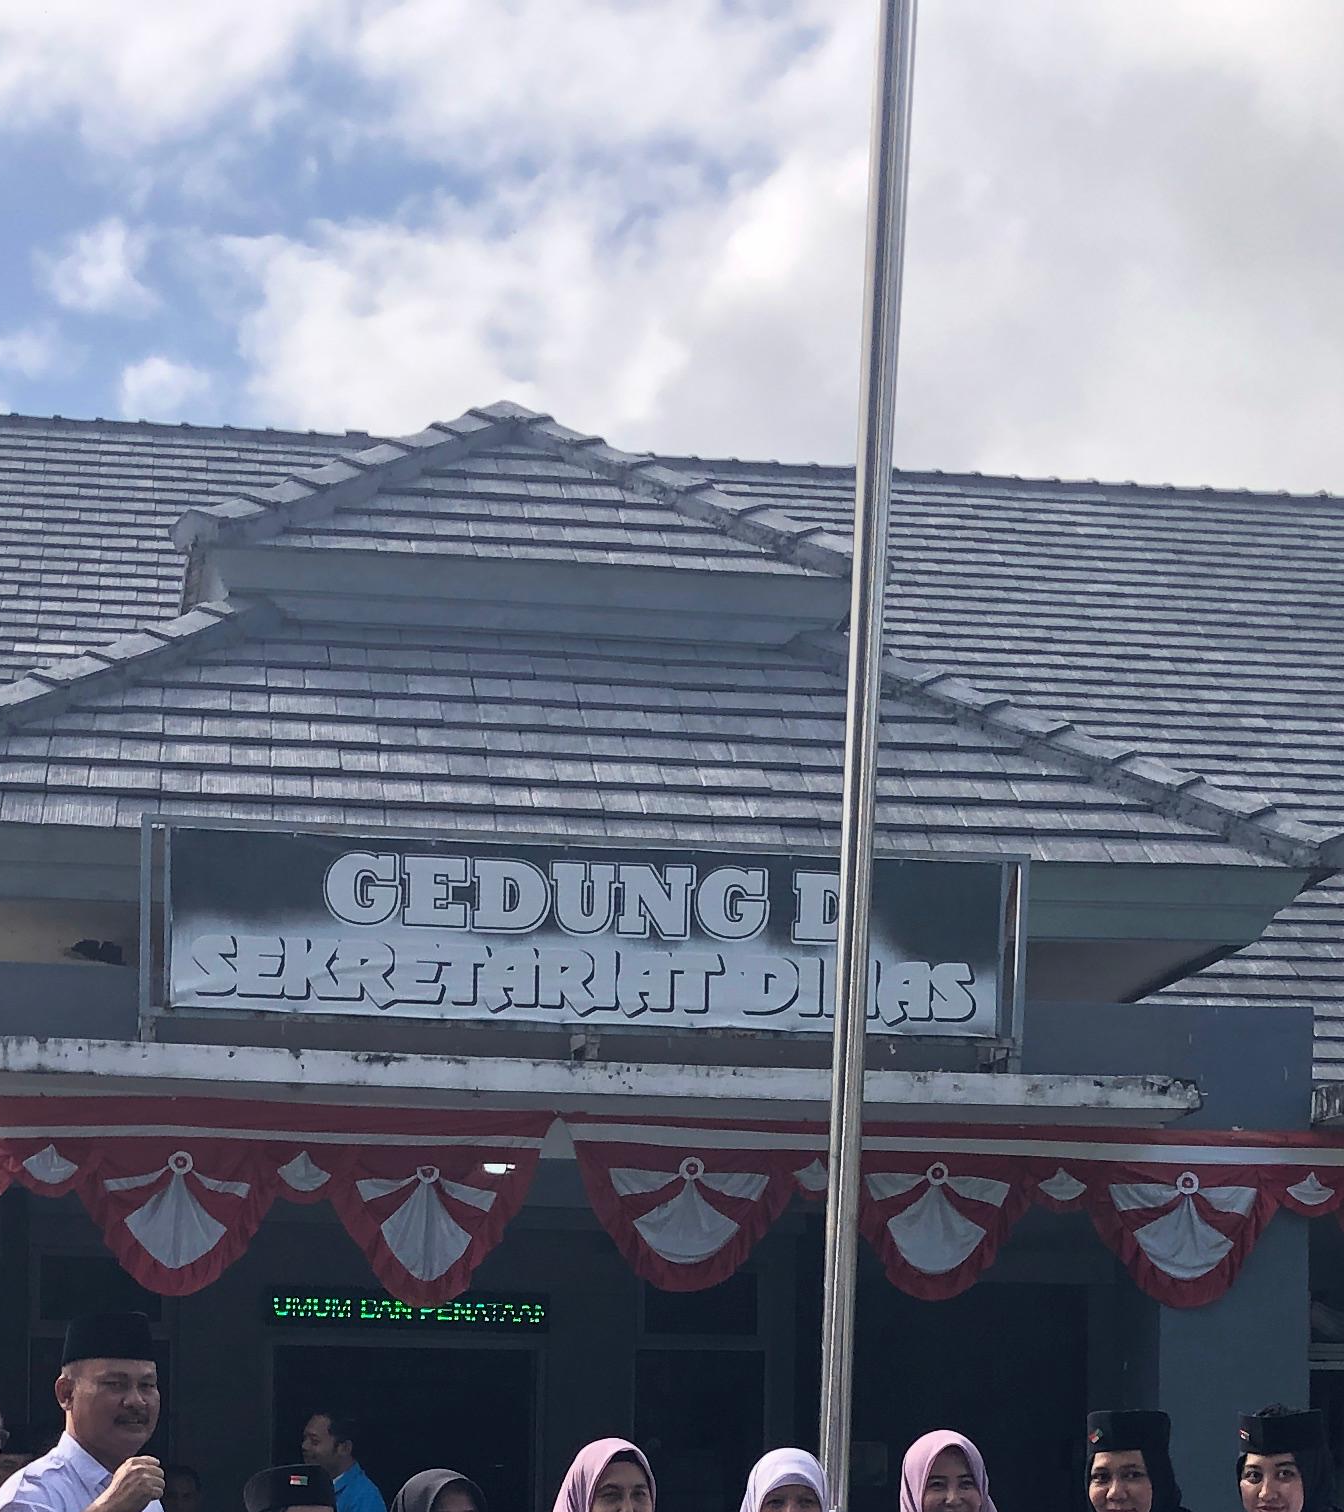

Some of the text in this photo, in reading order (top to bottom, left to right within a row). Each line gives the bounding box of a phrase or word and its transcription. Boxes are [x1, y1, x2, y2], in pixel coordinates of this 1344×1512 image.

[323, 849, 770, 942] GEDUNG
[191, 933, 726, 1018] SEKRETARIAT
[272, 1297, 351, 1319] UMUM
[360, 1299, 413, 1321] DAN
